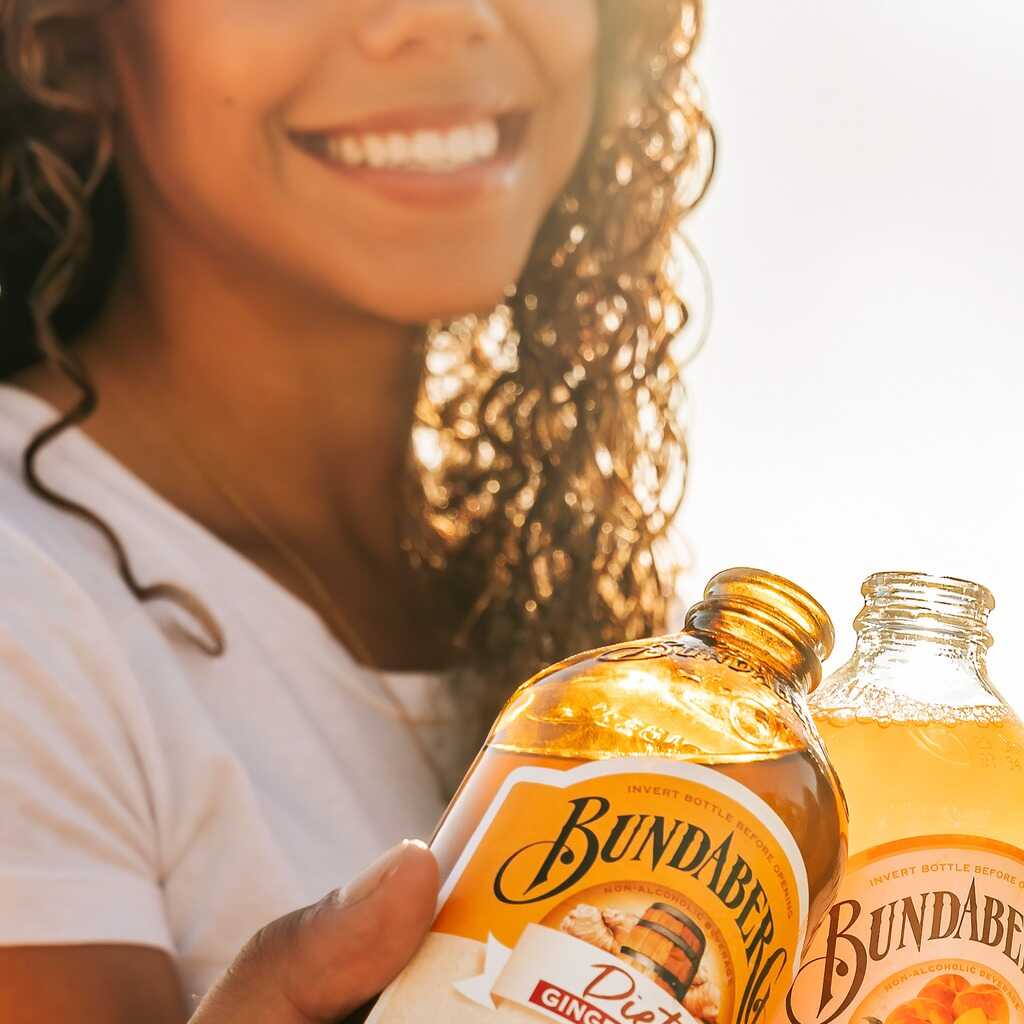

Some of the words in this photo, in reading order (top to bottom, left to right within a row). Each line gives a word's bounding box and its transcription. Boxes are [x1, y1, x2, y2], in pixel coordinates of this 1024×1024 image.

[628, 785, 680, 798] INVERT
[684, 794, 734, 823] BOTTLE
[736, 821, 774, 862] BEFORE
[774, 865, 794, 920] OPENING
[869, 866, 917, 888] INVERT
[921, 863, 971, 873] BOTTLE
[974, 865, 1017, 885] BEFORE
